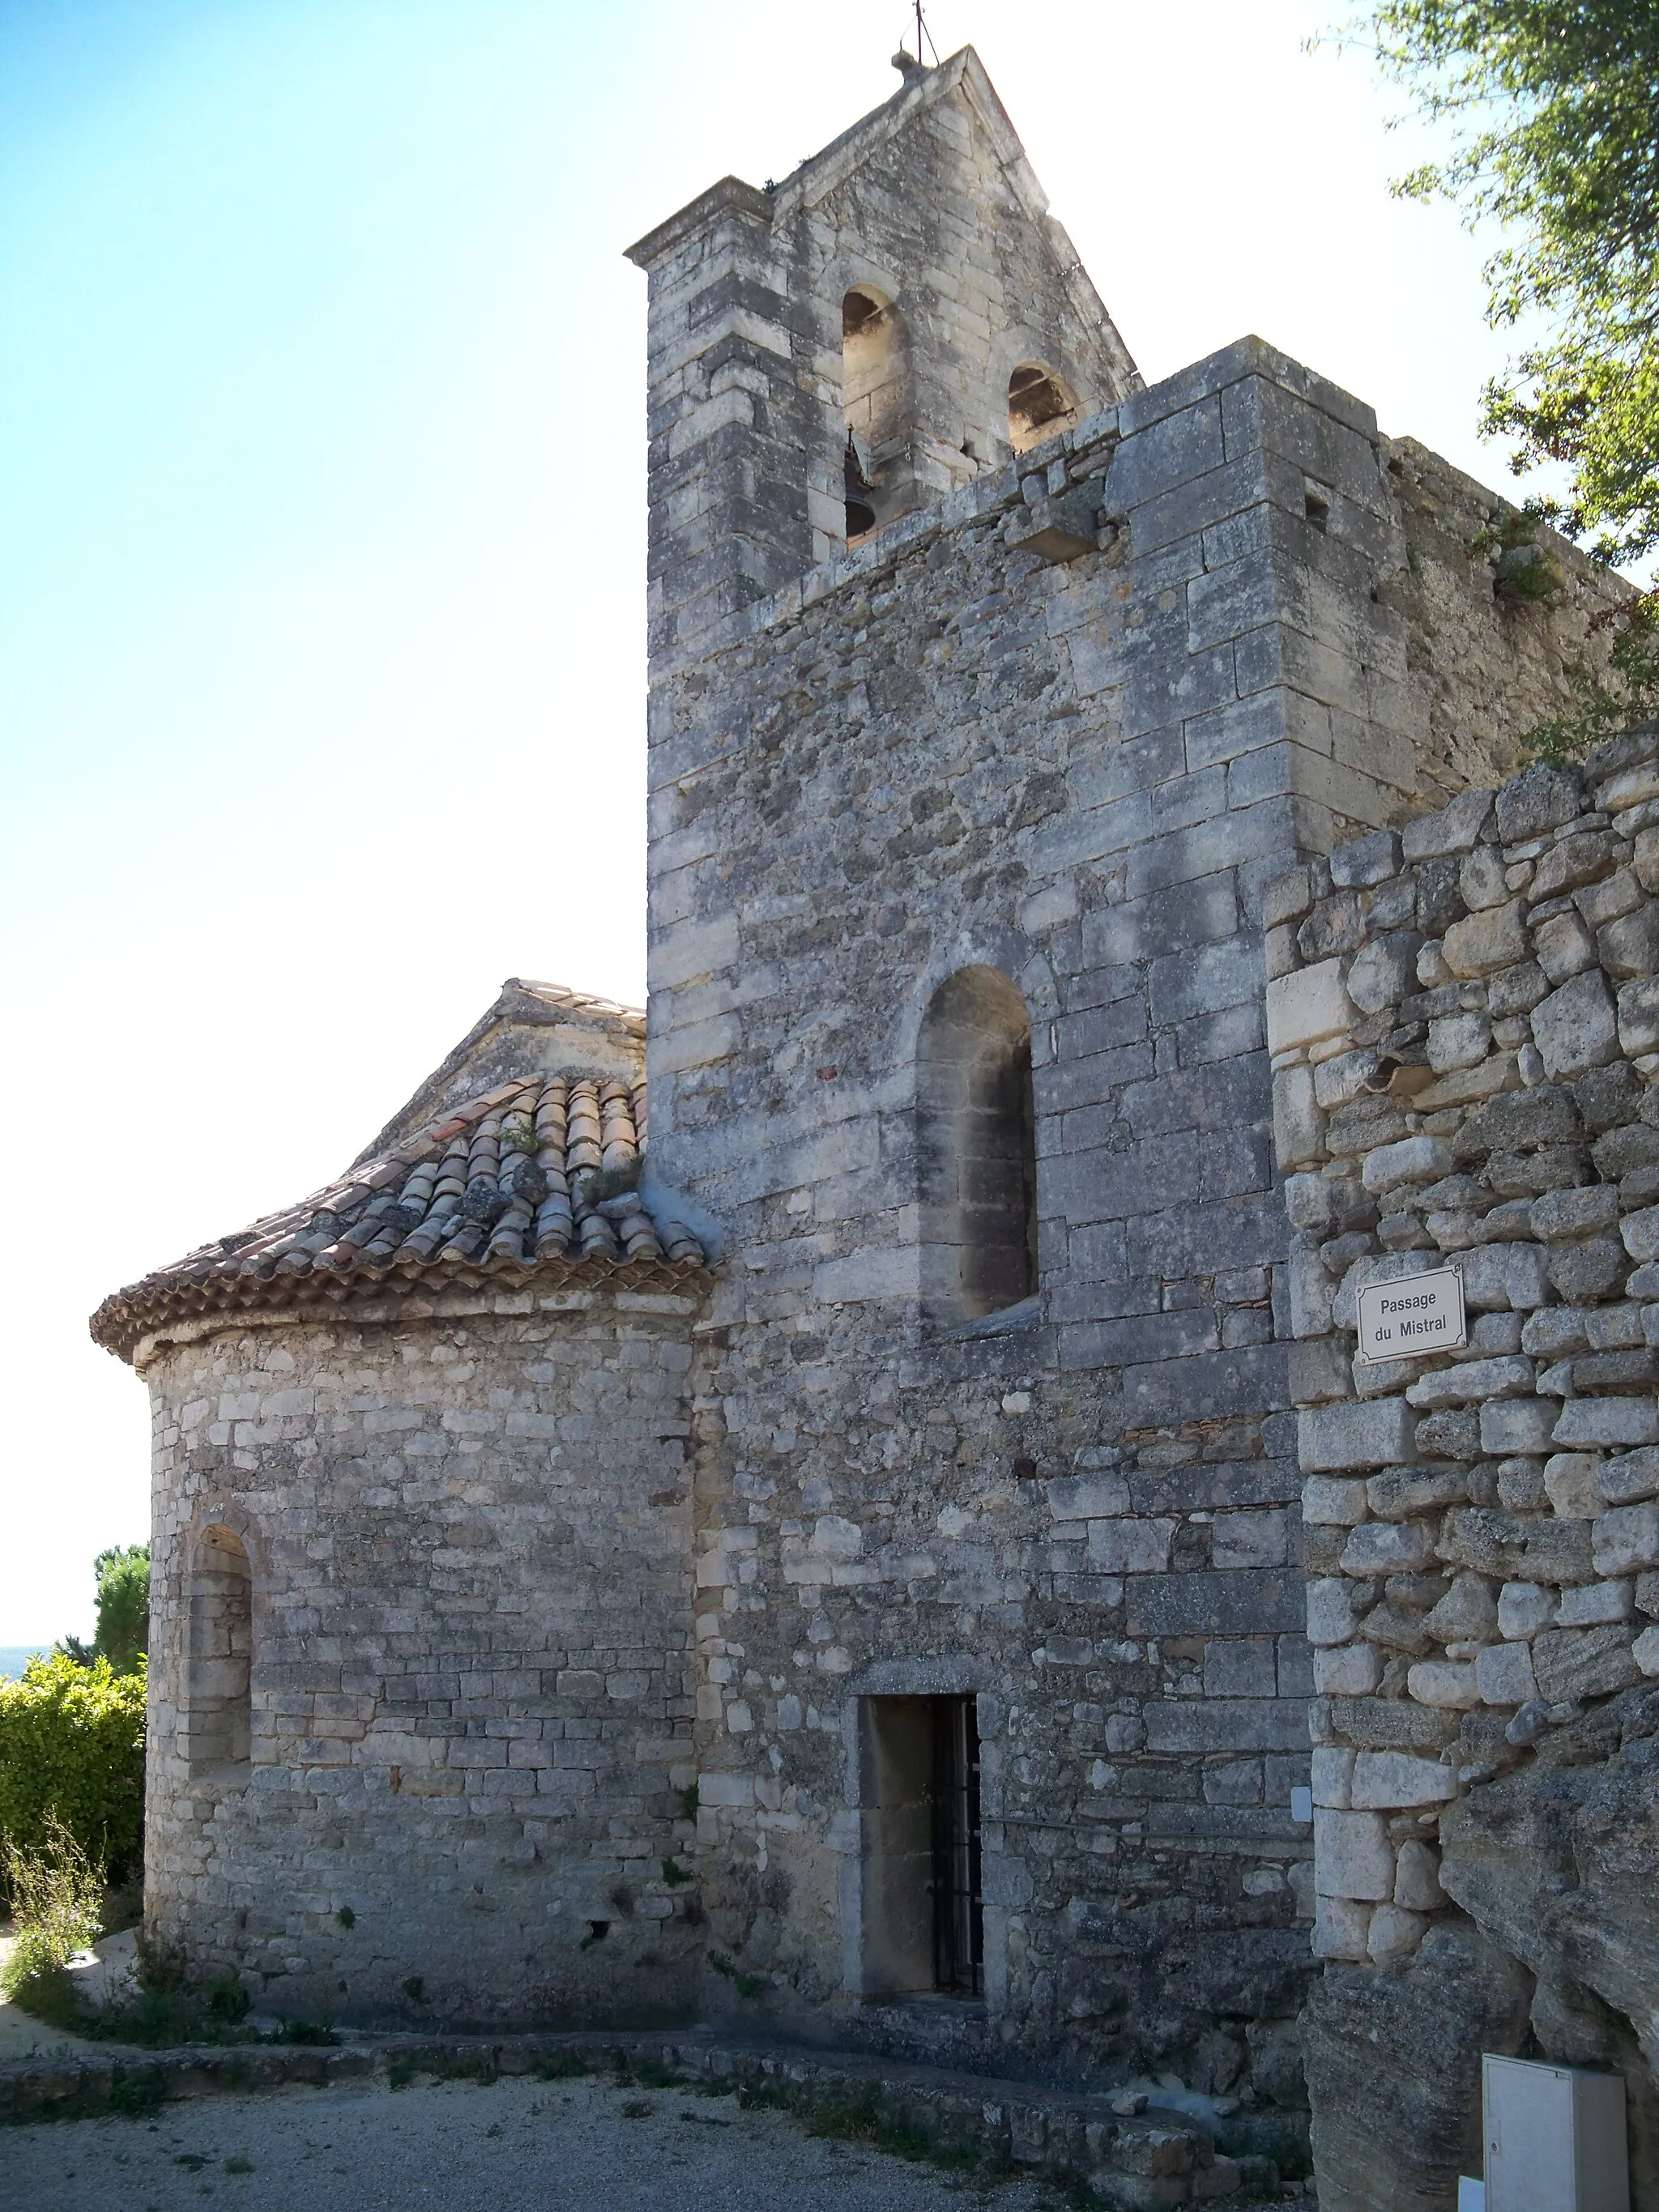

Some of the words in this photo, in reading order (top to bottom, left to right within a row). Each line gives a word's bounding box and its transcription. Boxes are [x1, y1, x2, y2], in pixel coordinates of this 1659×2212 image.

[1380, 1293, 1436, 1314] Passage
[1375, 1327, 1392, 1341] du
[1400, 1315, 1447, 1336] Mistral
